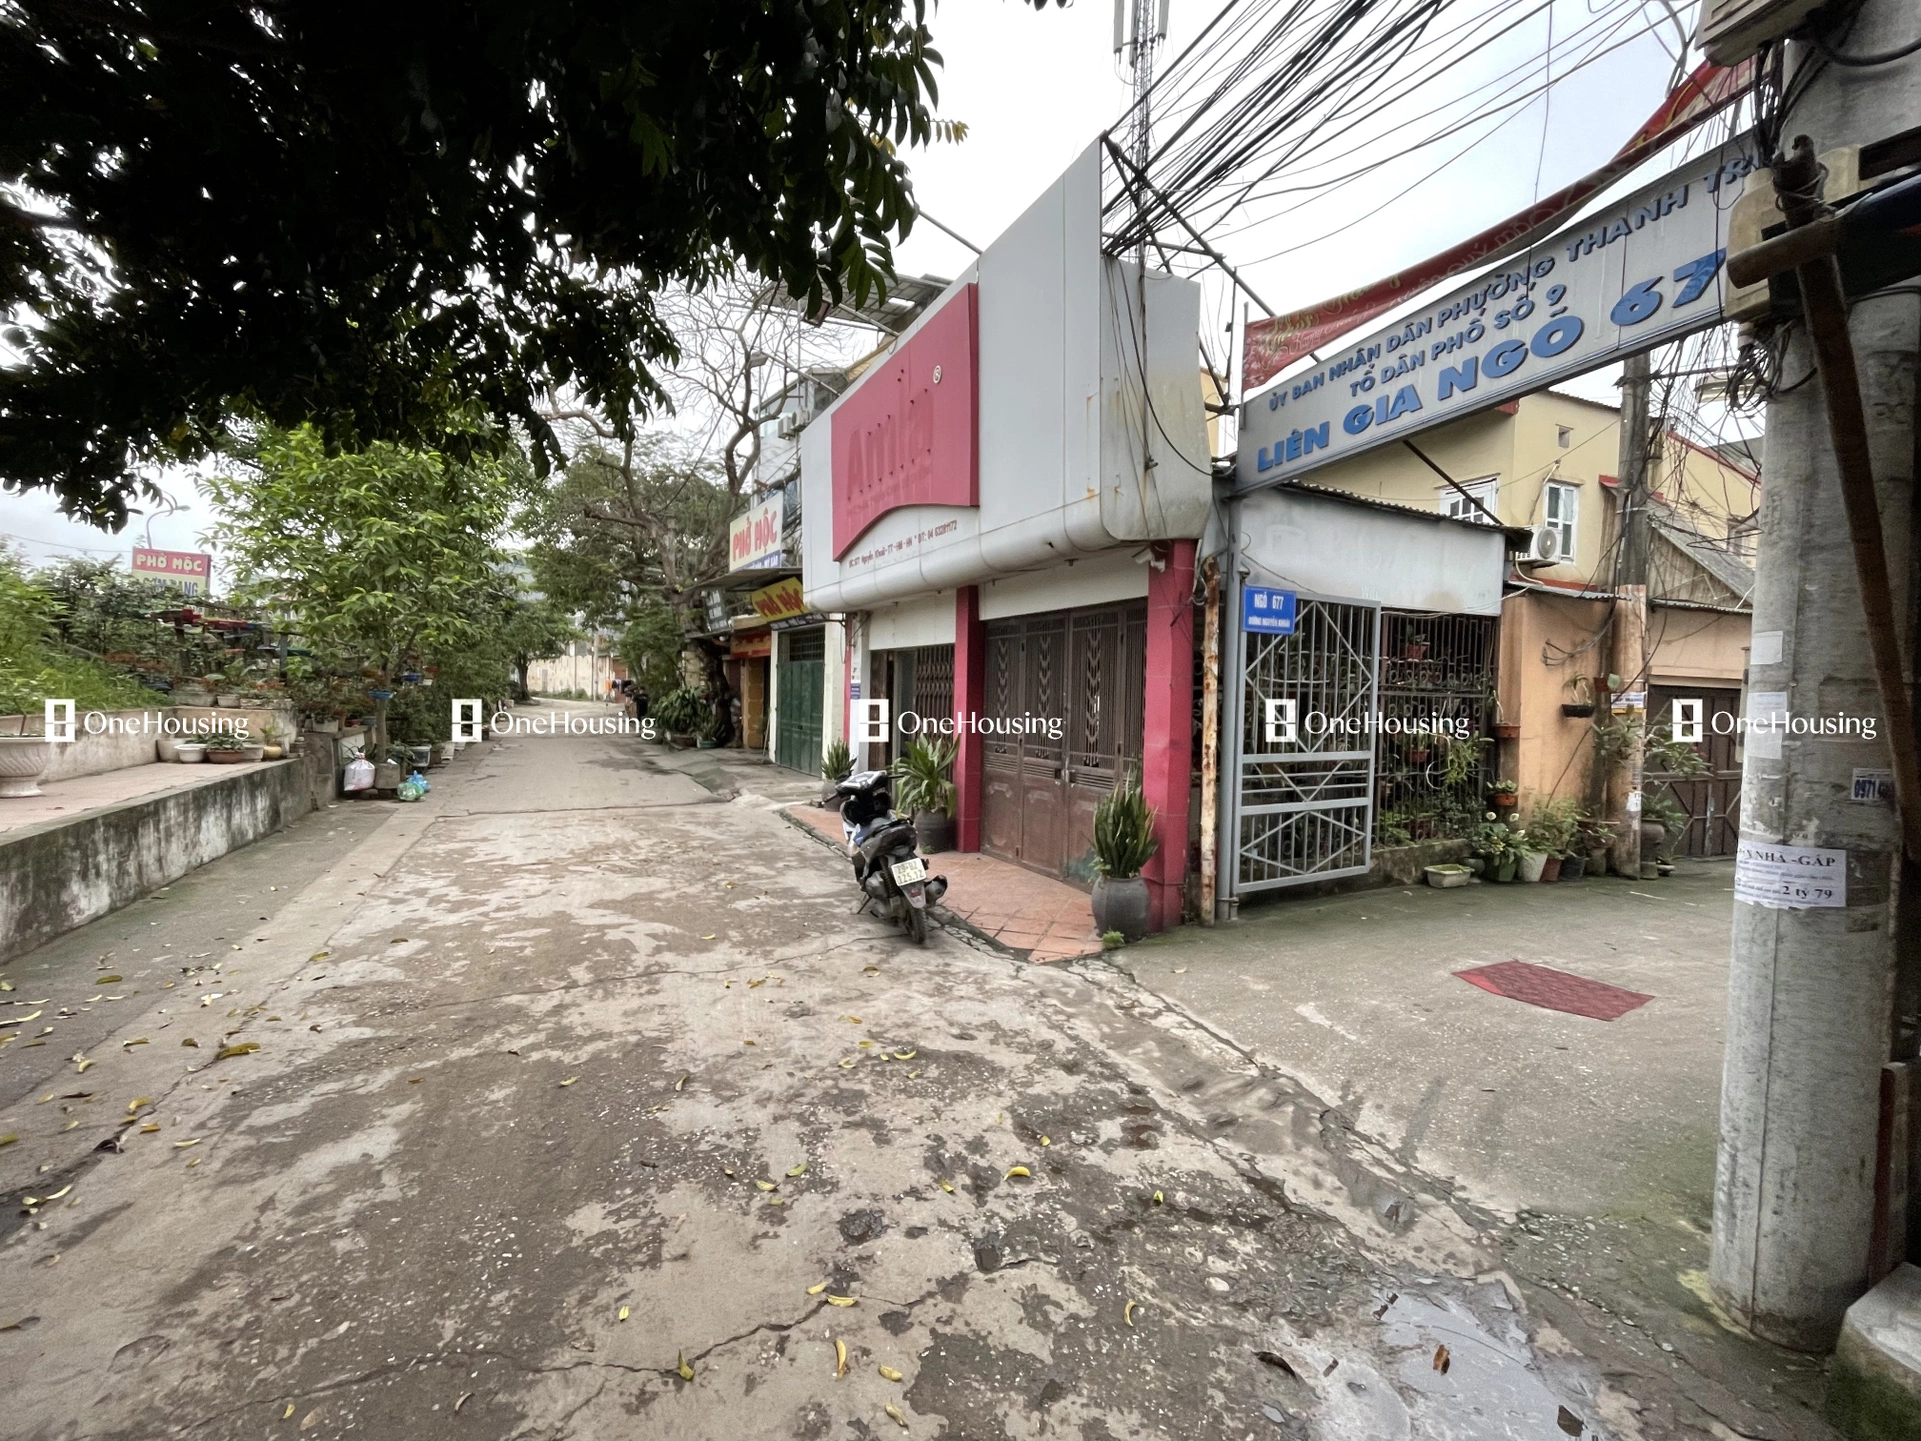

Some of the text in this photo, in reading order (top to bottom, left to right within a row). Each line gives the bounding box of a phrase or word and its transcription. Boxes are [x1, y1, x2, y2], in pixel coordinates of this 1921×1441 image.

[1291, 371, 1325, 400] BAN
[1328, 343, 1380, 382] NHÂN
[1385, 316, 1432, 353] DÂN
[1437, 256, 1555, 328] PHƯỜNG
[1566, 184, 1689, 262] THANH
[1350, 281, 1567, 397] TỔ DÂN PHỐ SỐ 9
[1257, 421, 1330, 473] LIÊN
[1343, 384, 1422, 435] GIA
[1437, 306, 1584, 401] NGÕ
[172, 556, 203, 573] MỘC
[732, 506, 777, 562] PHỞ MỘC
[1782, 885, 1791, 895] 2
[1814, 888, 1833, 899] 79
